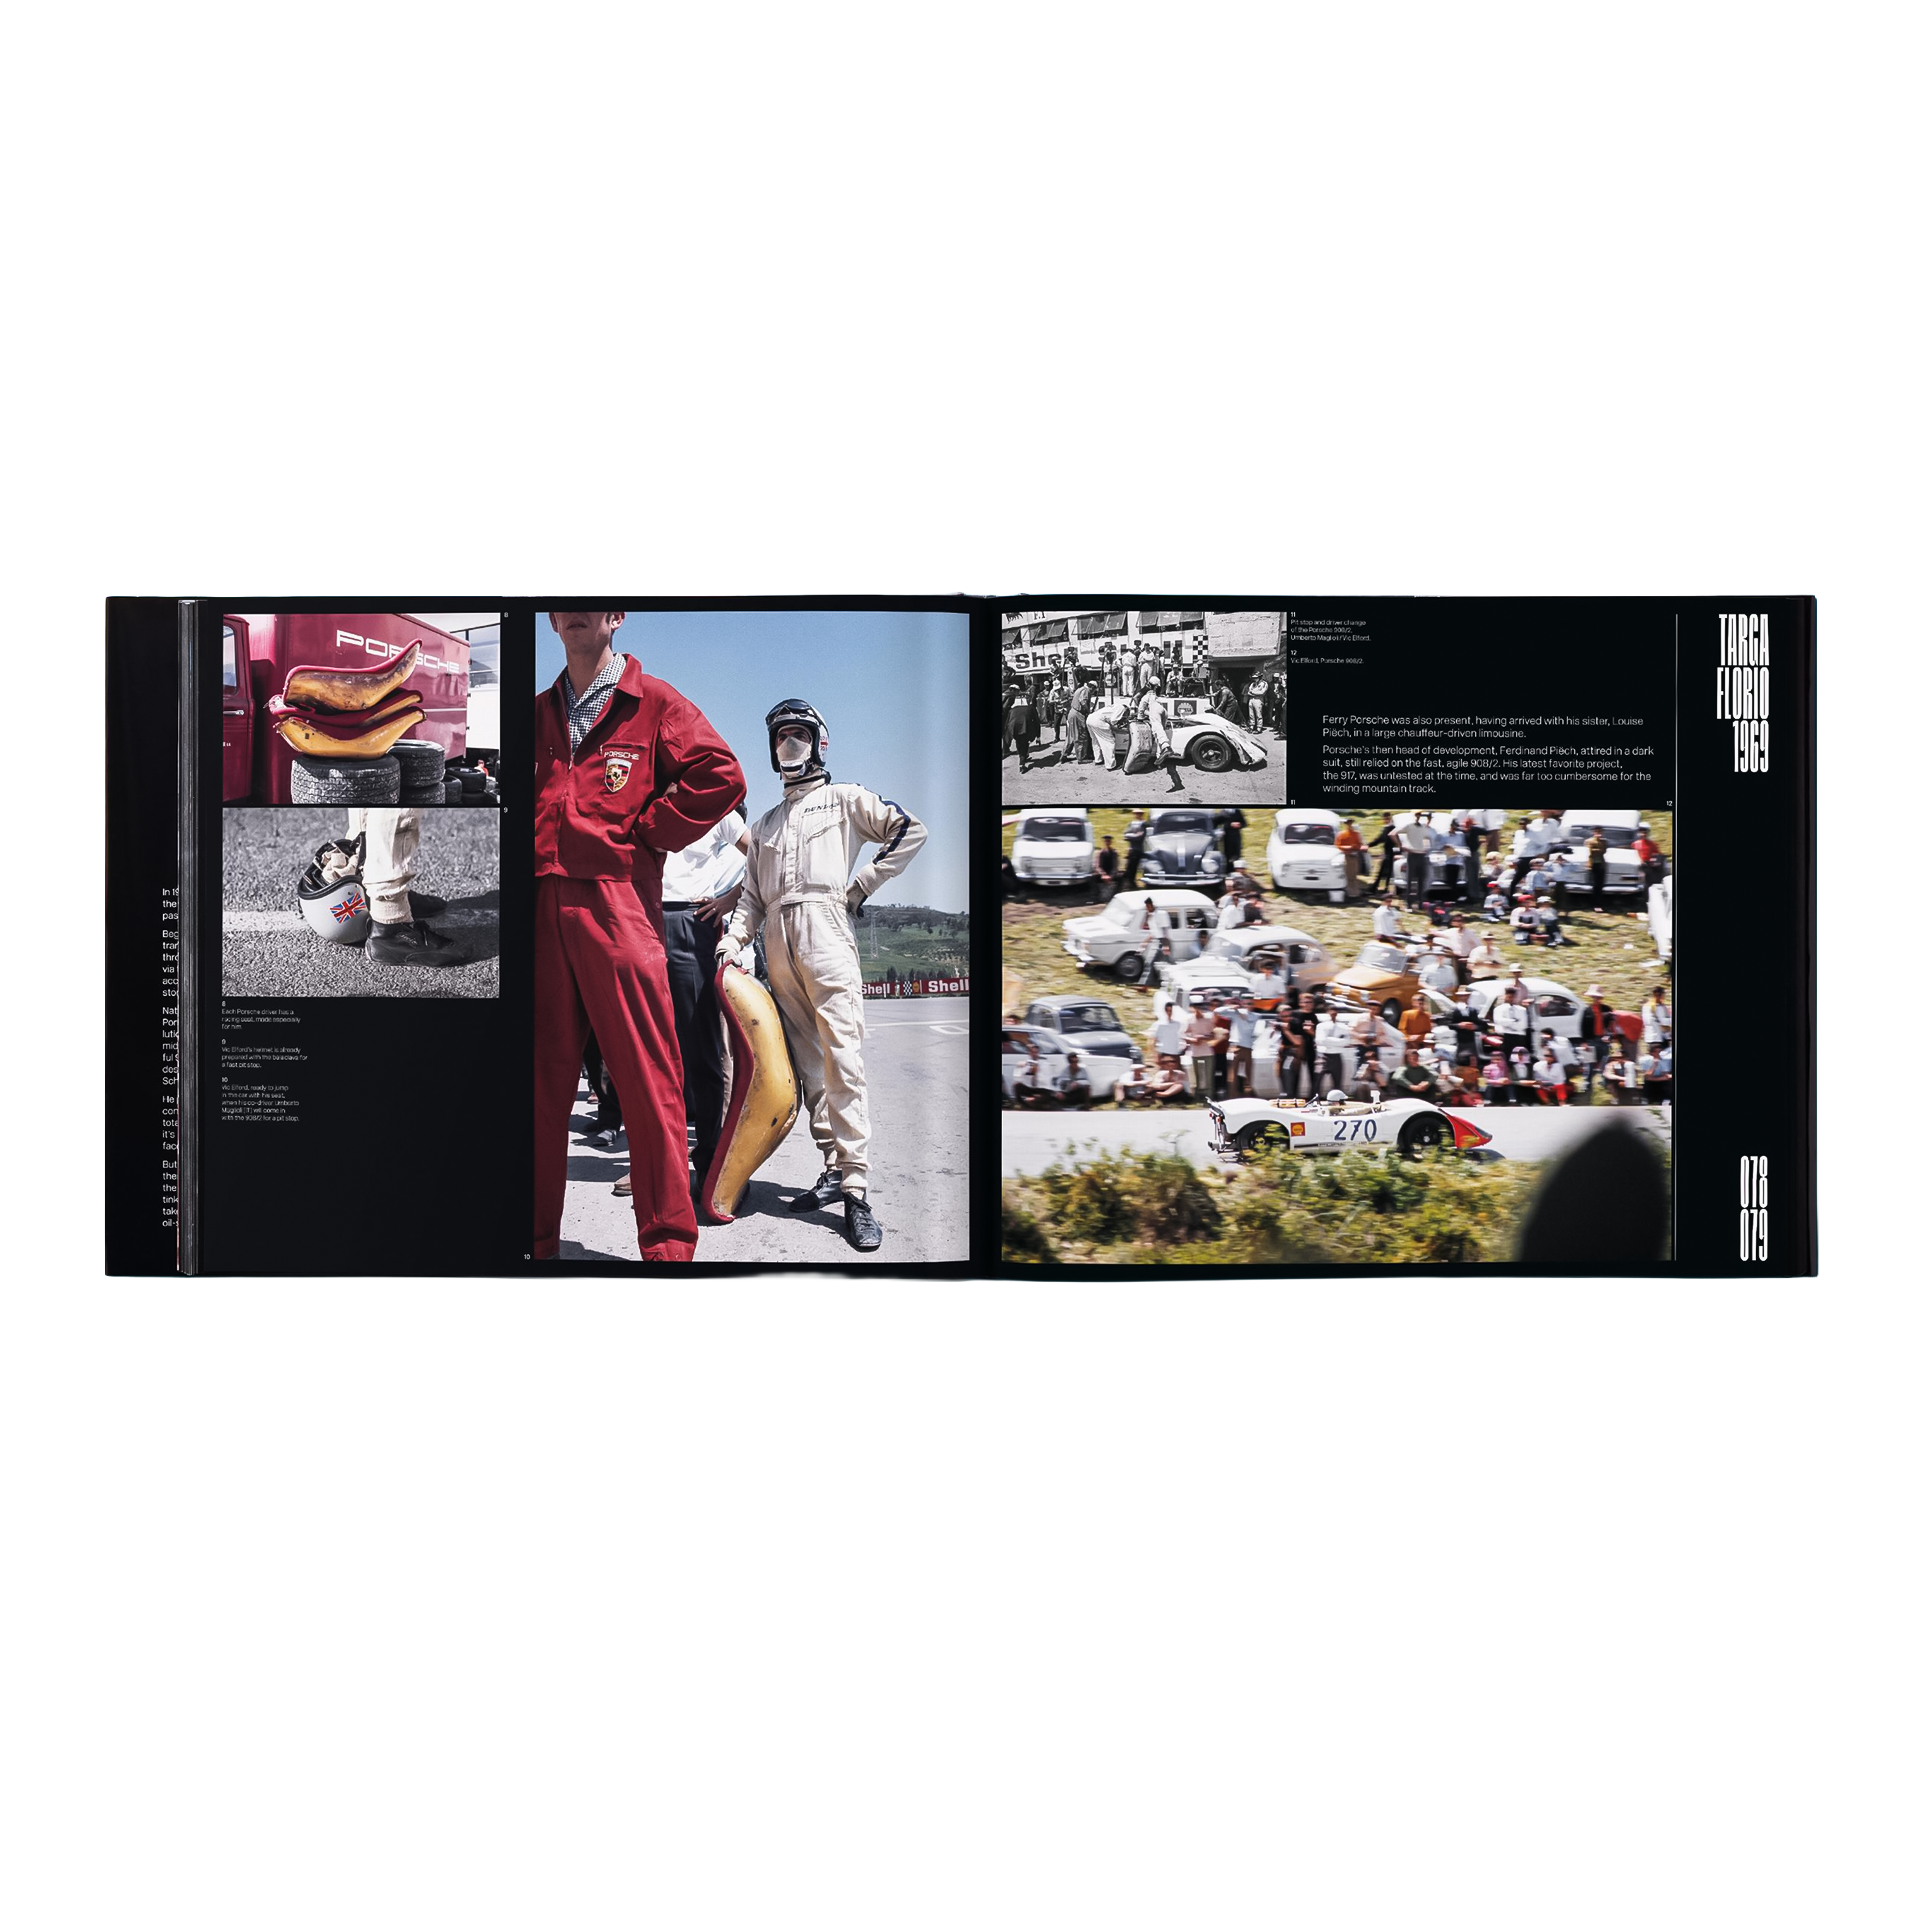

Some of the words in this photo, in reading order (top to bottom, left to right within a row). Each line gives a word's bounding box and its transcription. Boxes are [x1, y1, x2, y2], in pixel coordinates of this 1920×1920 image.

[1719, 614, 1769, 666] TARGA
[336, 630, 460, 674] PORSCHE
[1015, 648, 1078, 669] She
[1717, 667, 1769, 719] FLORIO
[1323, 715, 1348, 726] Ferry
[1351, 715, 1389, 724] Porsche
[1413, 716, 1432, 724] also
[1435, 717, 1473, 725] present,
[1476, 716, 1506, 727] having
[1509, 716, 1542, 725] arrived
[1544, 716, 1564, 725] with
[1567, 716, 1579, 725] his
[1582, 717, 1610, 726] sister,
[1613, 717, 1643, 725] Louise
[1323, 728, 1351, 737] Piëch,
[1354, 728, 1362, 736] in
[1372, 729, 1395, 738] large
[1398, 729, 1477, 737] chauffeur-driven
[1479, 729, 1526, 737] limousine.
[1323, 745, 1369, 754] Porsche's
[1396, 746, 1419, 754] head
[1422, 746, 1430, 754] of
[1433, 746, 1497, 756] development,
[1500, 746, 1547, 755] Ferdinand
[1550, 746, 1578, 755] Piëch,
[1581, 746, 1612, 755] attired
[1632, 746, 1654, 755] dark
[1733, 720, 1769, 772] 1969
[1323, 758, 1342, 767] suit,
[1346, 758, 1360, 767] still
[1363, 758, 1389, 767] relied
[1405, 758, 1420, 767] the
[1424, 758, 1444, 767] fast,
[1447, 759, 1468, 769] agile
[1471, 759, 1500, 768] 908/2.
[1521, 760, 1546, 768] latest
[1549, 759, 1584, 768] favorite
[1587, 759, 1622, 769] project,
[1323, 771, 1338, 779] the
[1341, 771, 1357, 780] 917,
[1380, 772, 1422, 780] untested
[1425, 772, 1433, 780] at
[1437, 772, 1452, 780] the
[1480, 772, 1498, 780] and
[1522, 771, 1534, 780] far
[1555, 772, 1618, 780] cumbersome
[1620, 772, 1633, 780] for
[1636, 772, 1651, 780] the
[1323, 785, 1359, 794] winding
[1409, 784, 1436, 792] track.
[163, 888, 170, 896] In
[163, 900, 177, 908] the
[162, 964, 175, 973] via
[862, 983, 890, 995] Shell
[928, 978, 969, 993] Shell
[1334, 1119, 1377, 1141] 270
[163, 1161, 177, 1169] But
[163, 1172, 177, 1180] the
[1741, 1156, 1768, 1208] 078
[1740, 1209, 1768, 1261] 079
